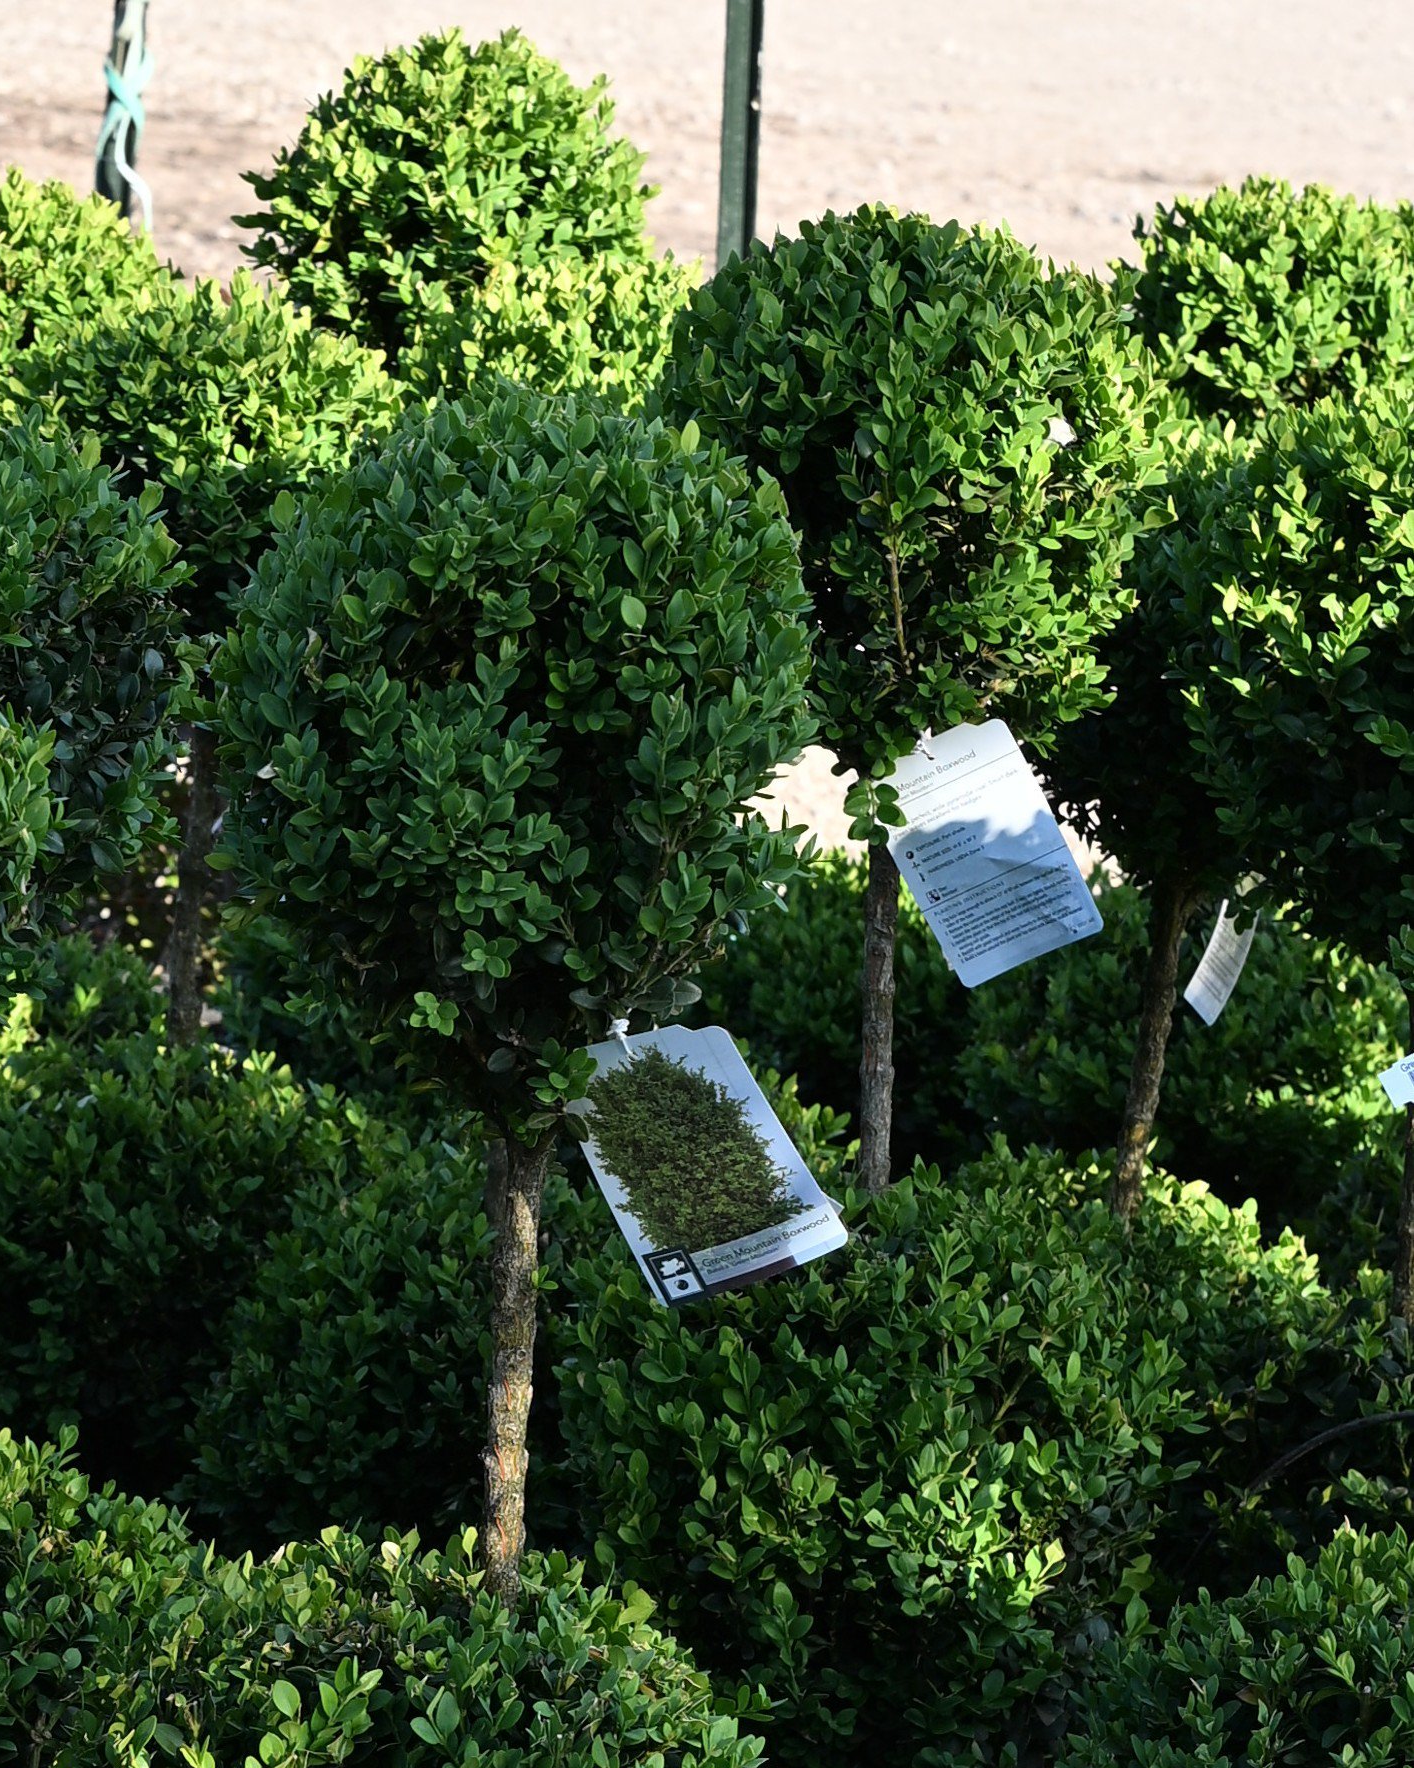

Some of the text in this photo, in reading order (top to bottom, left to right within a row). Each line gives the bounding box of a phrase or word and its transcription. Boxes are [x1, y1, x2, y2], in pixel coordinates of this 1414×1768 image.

[896, 771, 935, 792] Mountain
[936, 749, 976, 774] Boxwood
[702, 1213, 830, 1268] Green Mountain Boxwood
